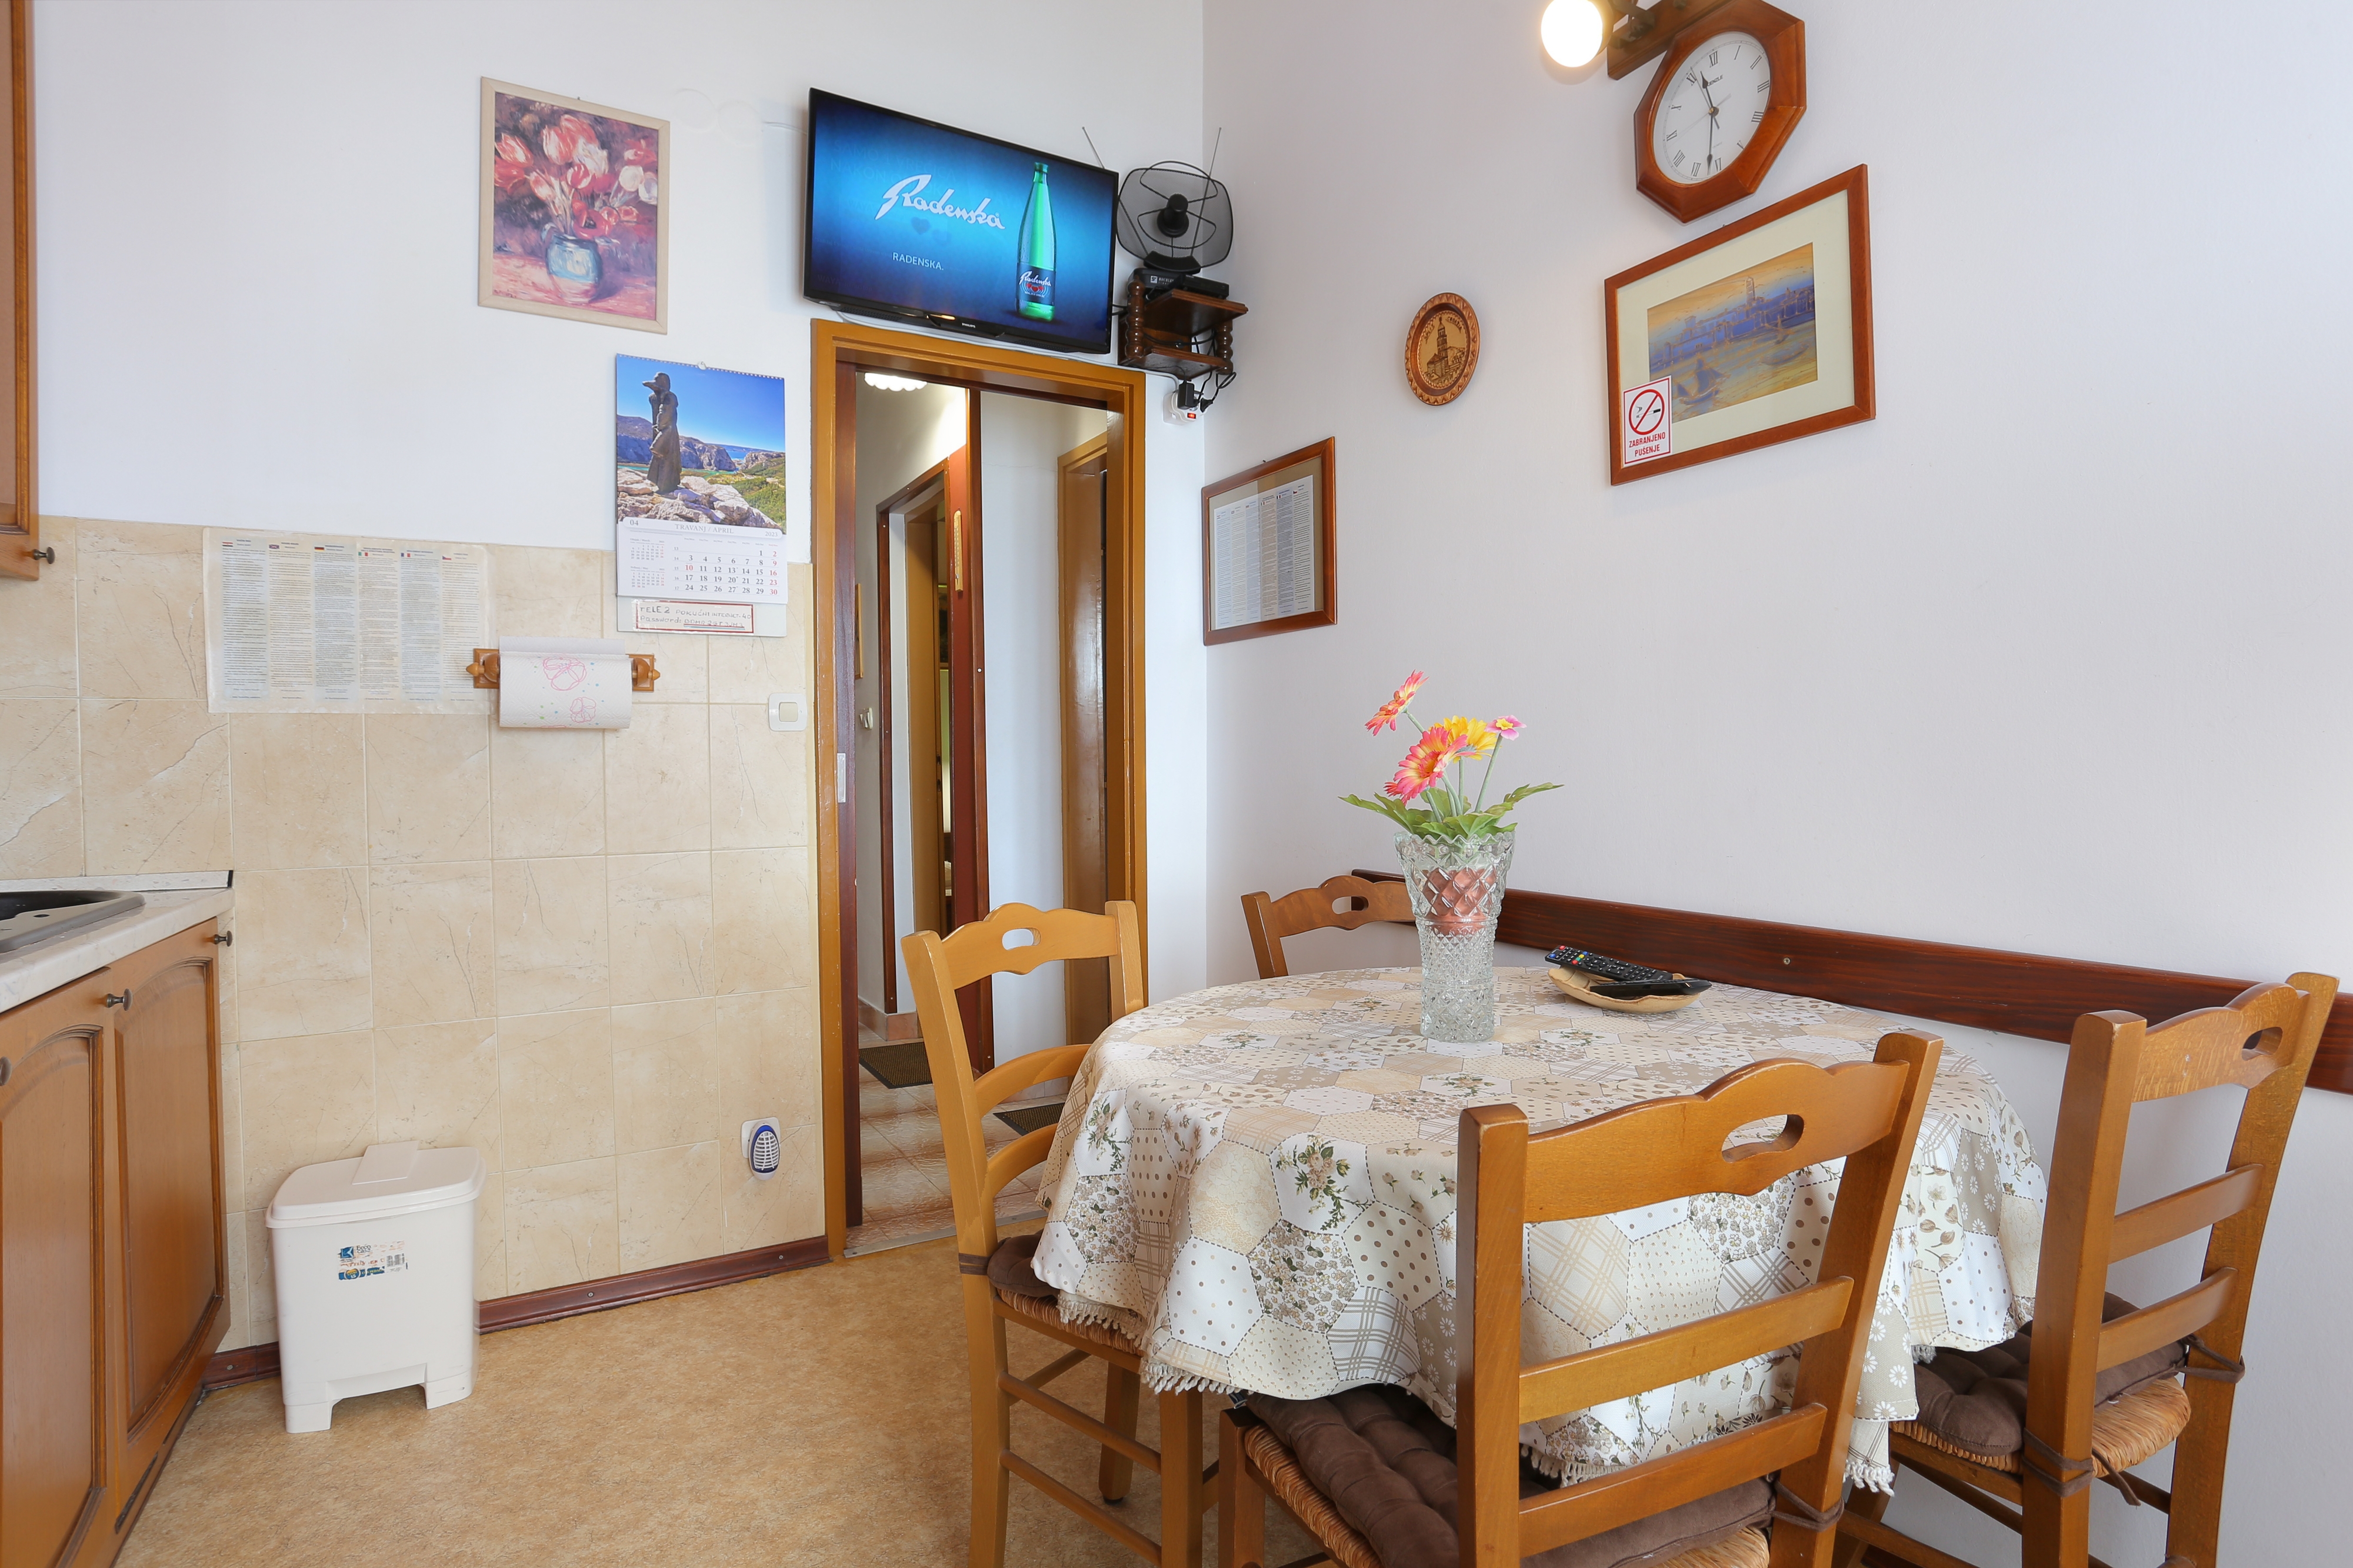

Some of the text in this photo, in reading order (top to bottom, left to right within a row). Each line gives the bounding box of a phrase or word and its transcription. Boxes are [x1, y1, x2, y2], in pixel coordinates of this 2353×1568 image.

[1709, 51, 1718, 68] XII
[1686, 72, 1697, 86] XI
[1757, 79, 1769, 94] III
[1691, 162, 1702, 177] VII
[875, 174, 1005, 229] Radenska
[892, 252, 944, 271] RADENSKA.
[1019, 271, 1051, 286] Radenska
[1629, 432, 1666, 448] ZABRANJENO
[1635, 444, 1661, 457] PUŠENJE
[675, 523, 706, 532] TRAVANJ
[640, 615, 682, 623] Password:
